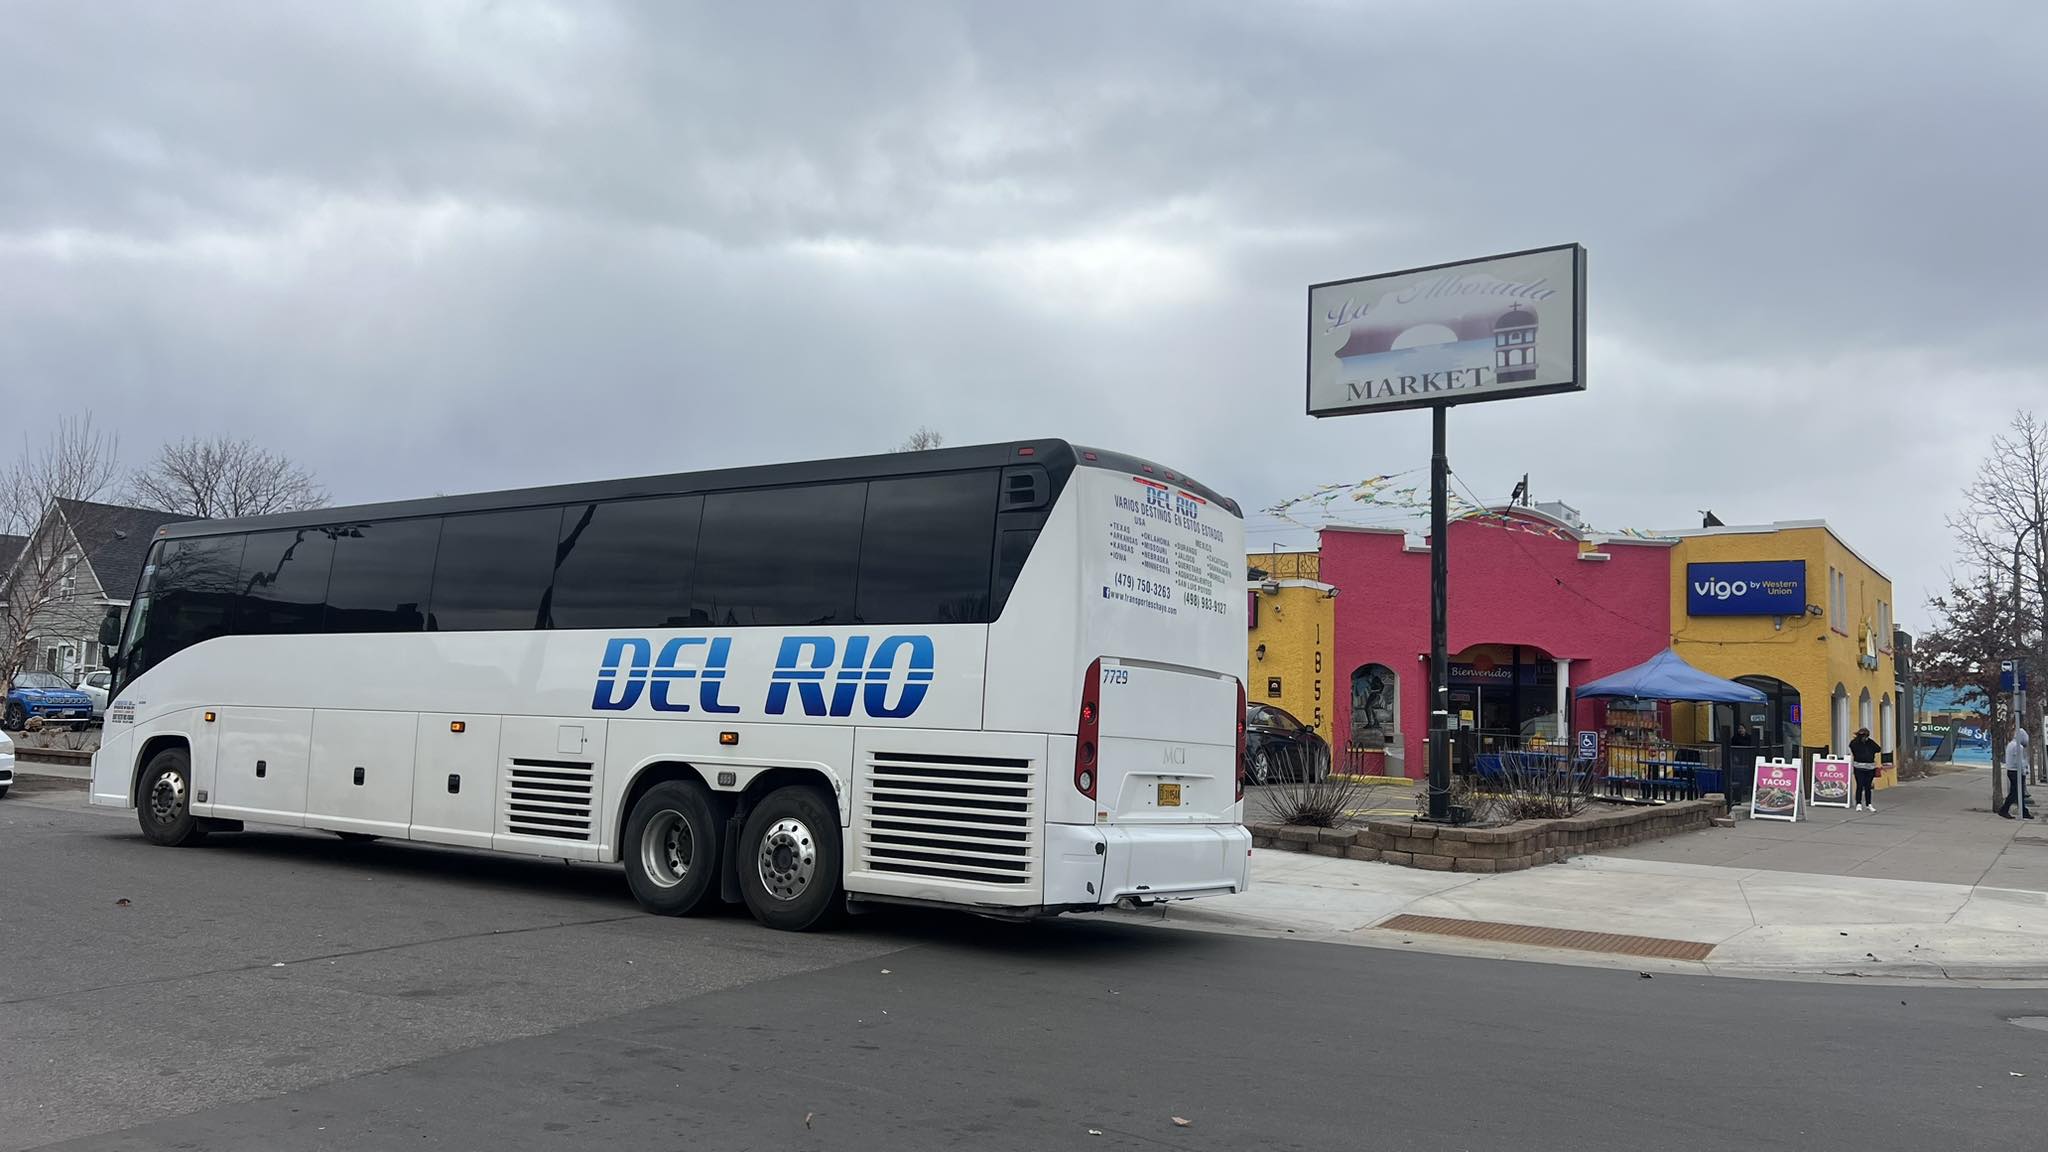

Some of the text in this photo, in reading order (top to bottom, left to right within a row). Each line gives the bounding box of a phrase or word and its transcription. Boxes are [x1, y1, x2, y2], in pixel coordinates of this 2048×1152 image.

[1325, 275, 1556, 335] La Alborada
[1347, 366, 1490, 402] MARKET
[1147, 486, 1198, 519] DEL RIO
[1114, 494, 1223, 543] VARIOS DESTINOS EN ESTOS ESTADOS
[1134, 516, 1146, 527] USA
[1113, 522, 1130, 534] TEXAS
[1113, 532, 1138, 546] ARKANSAS
[1113, 541, 1134, 554] KANSAS
[1114, 571, 1171, 600] (479) 750-3263
[1694, 577, 1798, 600] vigo by Western
[591, 634, 935, 719] DEL RIO
[1103, 669, 1128, 684] 7729
[1451, 667, 1512, 678] Bienvenidos
[1958, 726, 1988, 741] Lake St
[1163, 747, 1185, 764] MCI
[1762, 778, 1792, 786] TACOS
